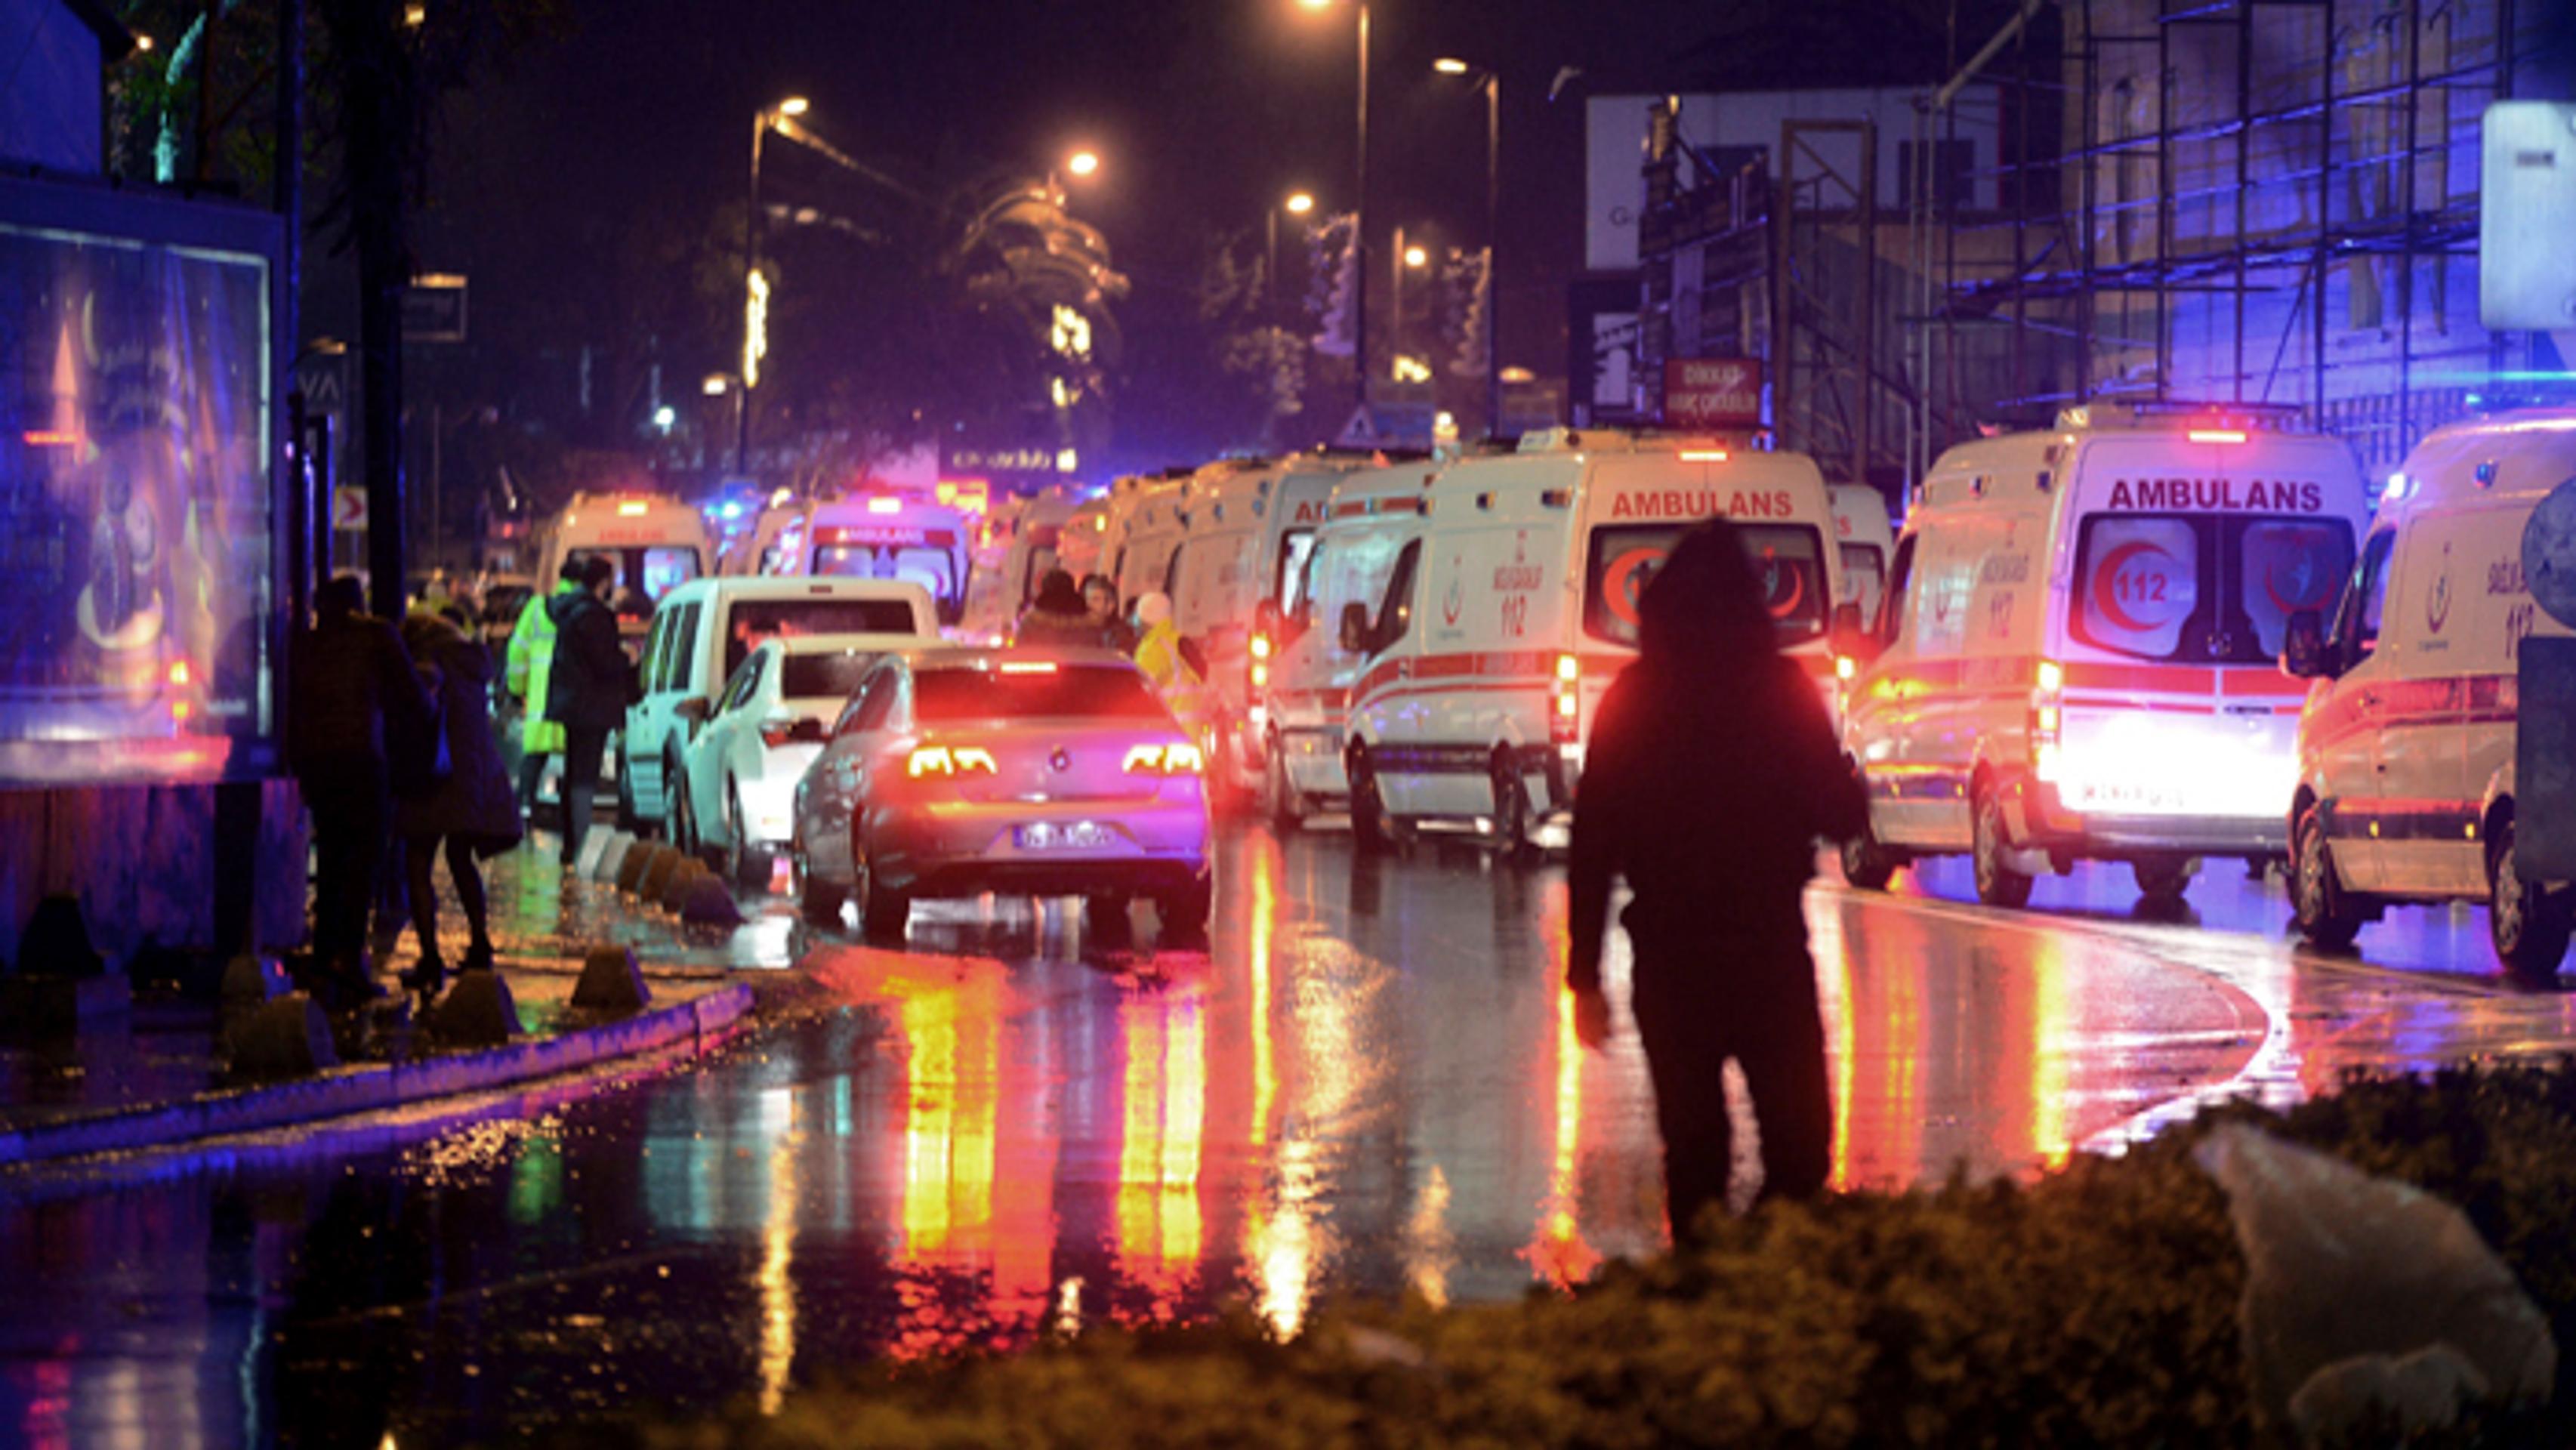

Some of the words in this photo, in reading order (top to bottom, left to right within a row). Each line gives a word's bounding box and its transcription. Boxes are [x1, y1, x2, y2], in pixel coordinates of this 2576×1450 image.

[1612, 490, 1793, 517] AMBULANS
[2109, 479, 2321, 511] AMBULANS
[2116, 572, 2167, 602] 112
